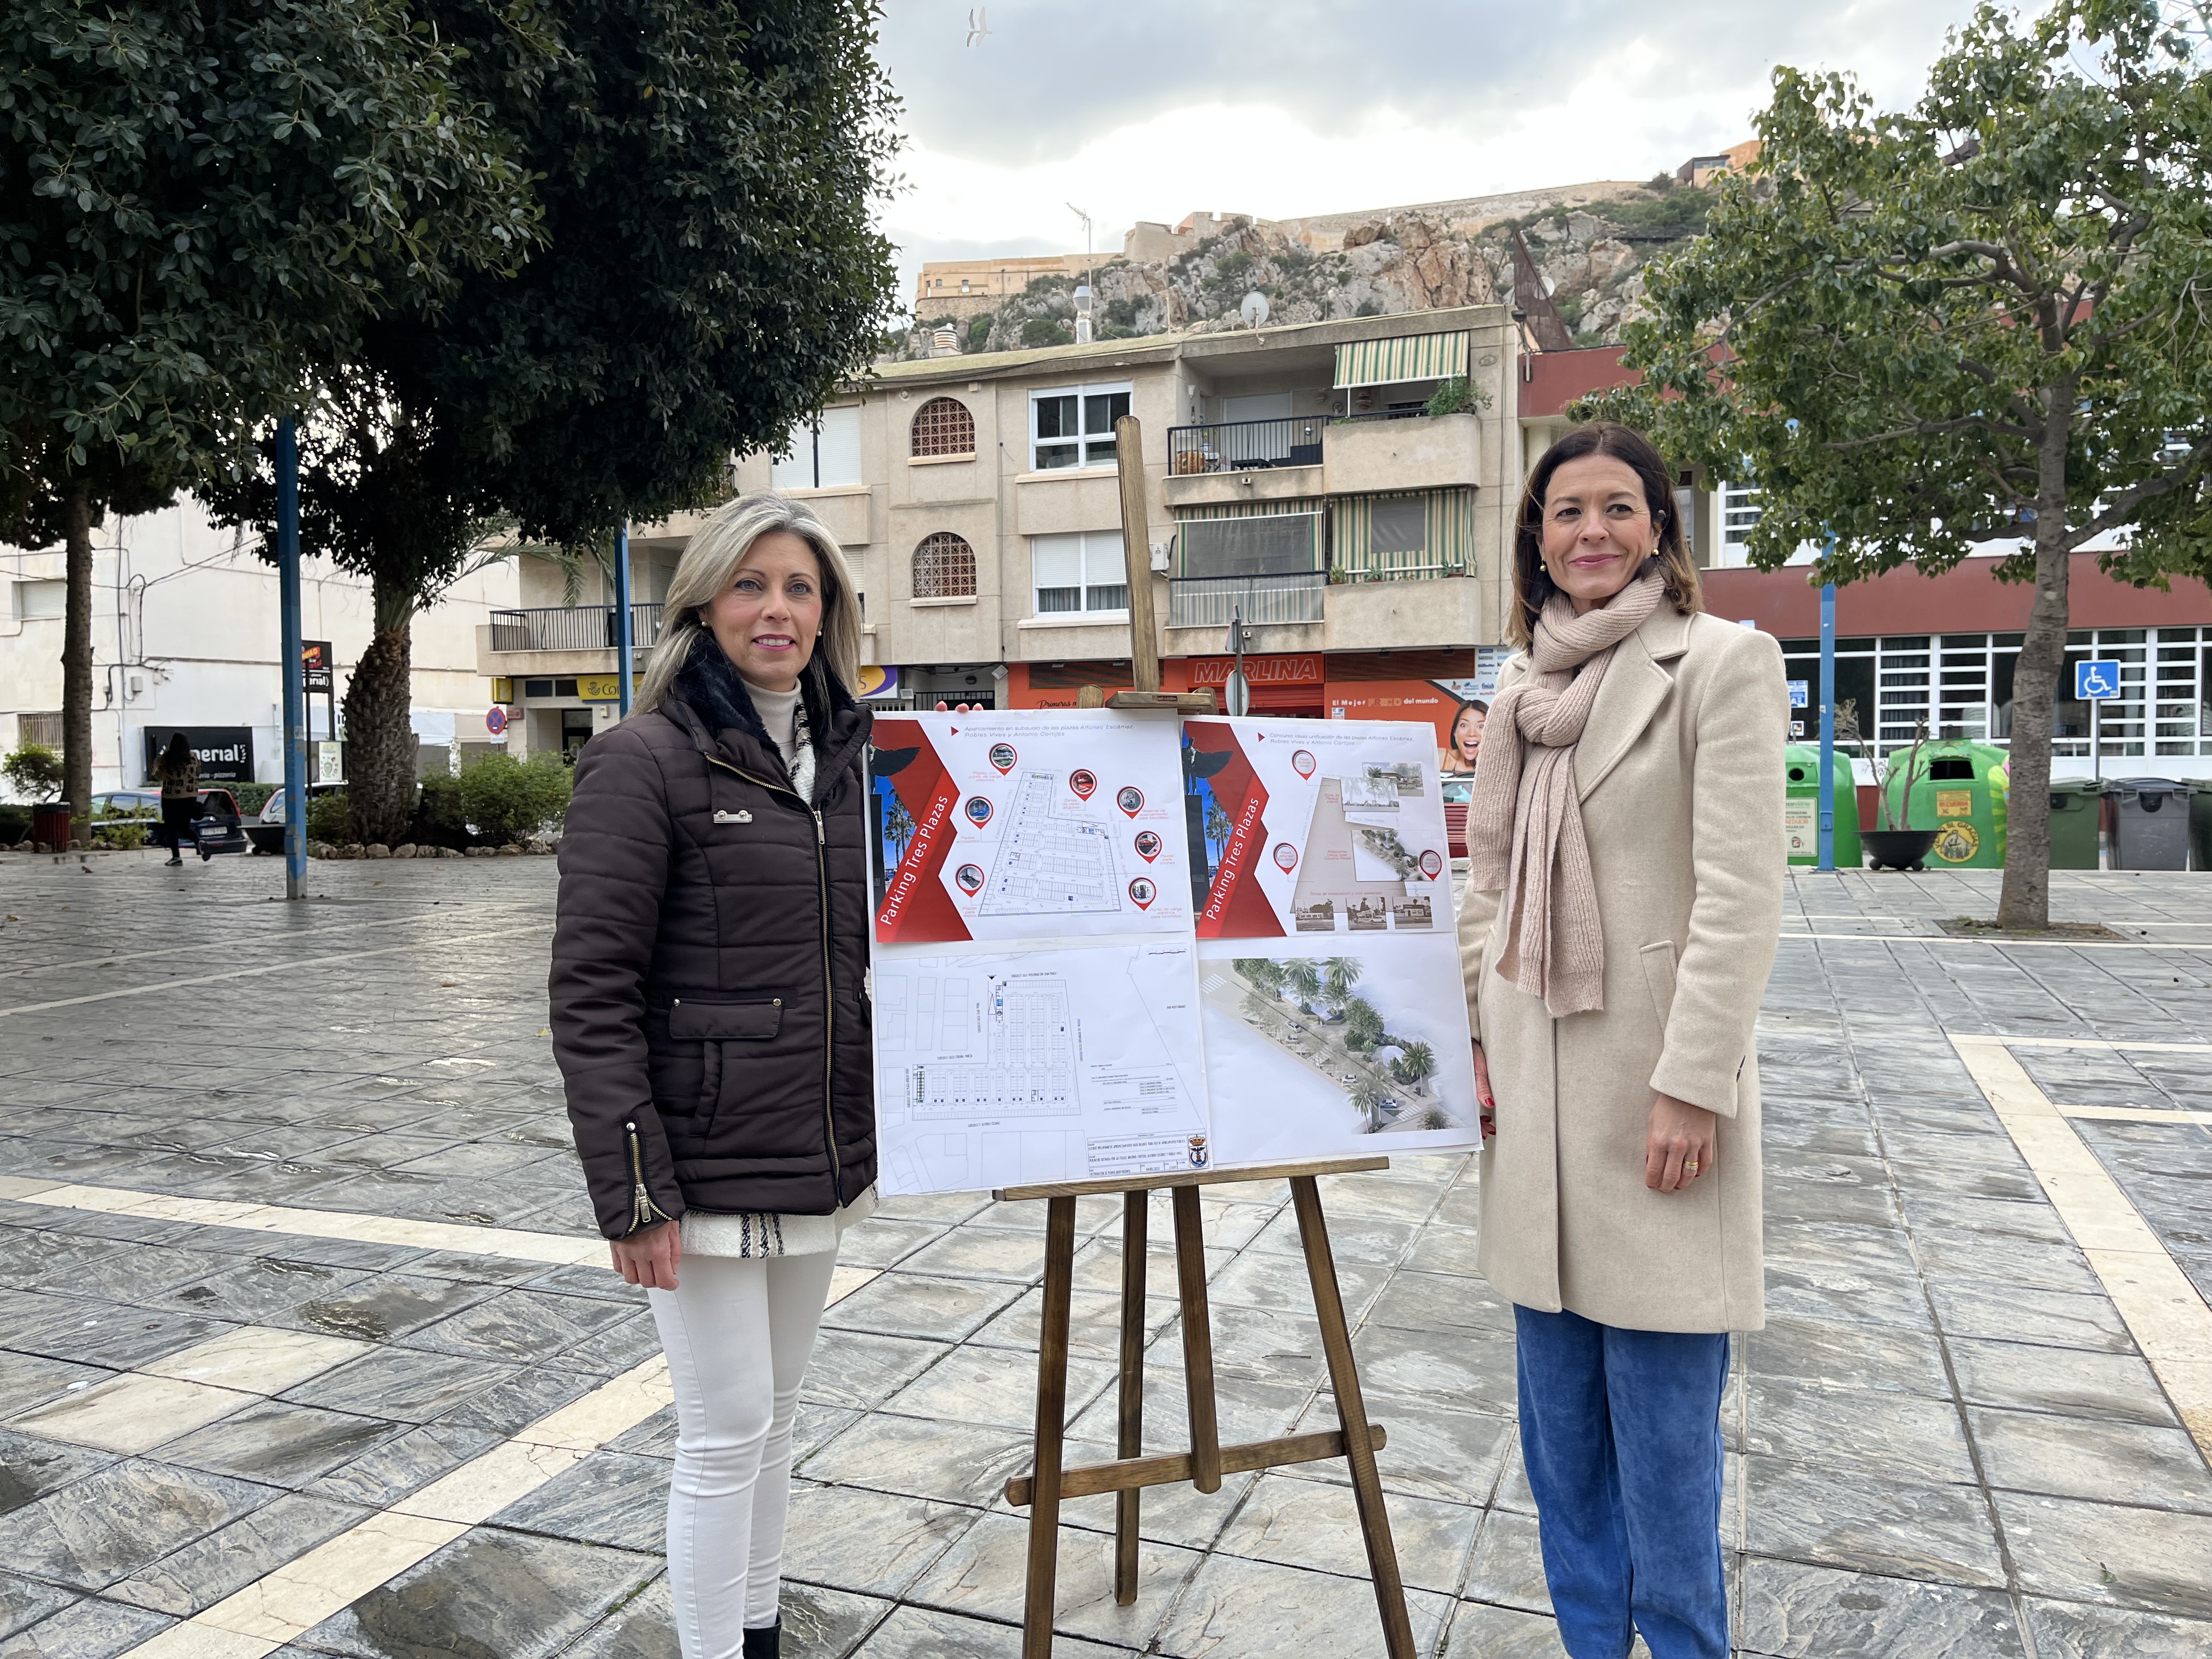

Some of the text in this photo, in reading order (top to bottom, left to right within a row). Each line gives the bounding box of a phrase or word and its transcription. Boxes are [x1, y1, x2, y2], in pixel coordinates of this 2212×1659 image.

[1194, 658, 1317, 683] MARLINA
[881, 795, 948, 926] Parking Tres Plazas
[1206, 798, 1259, 921] Parking Tres Plazas
